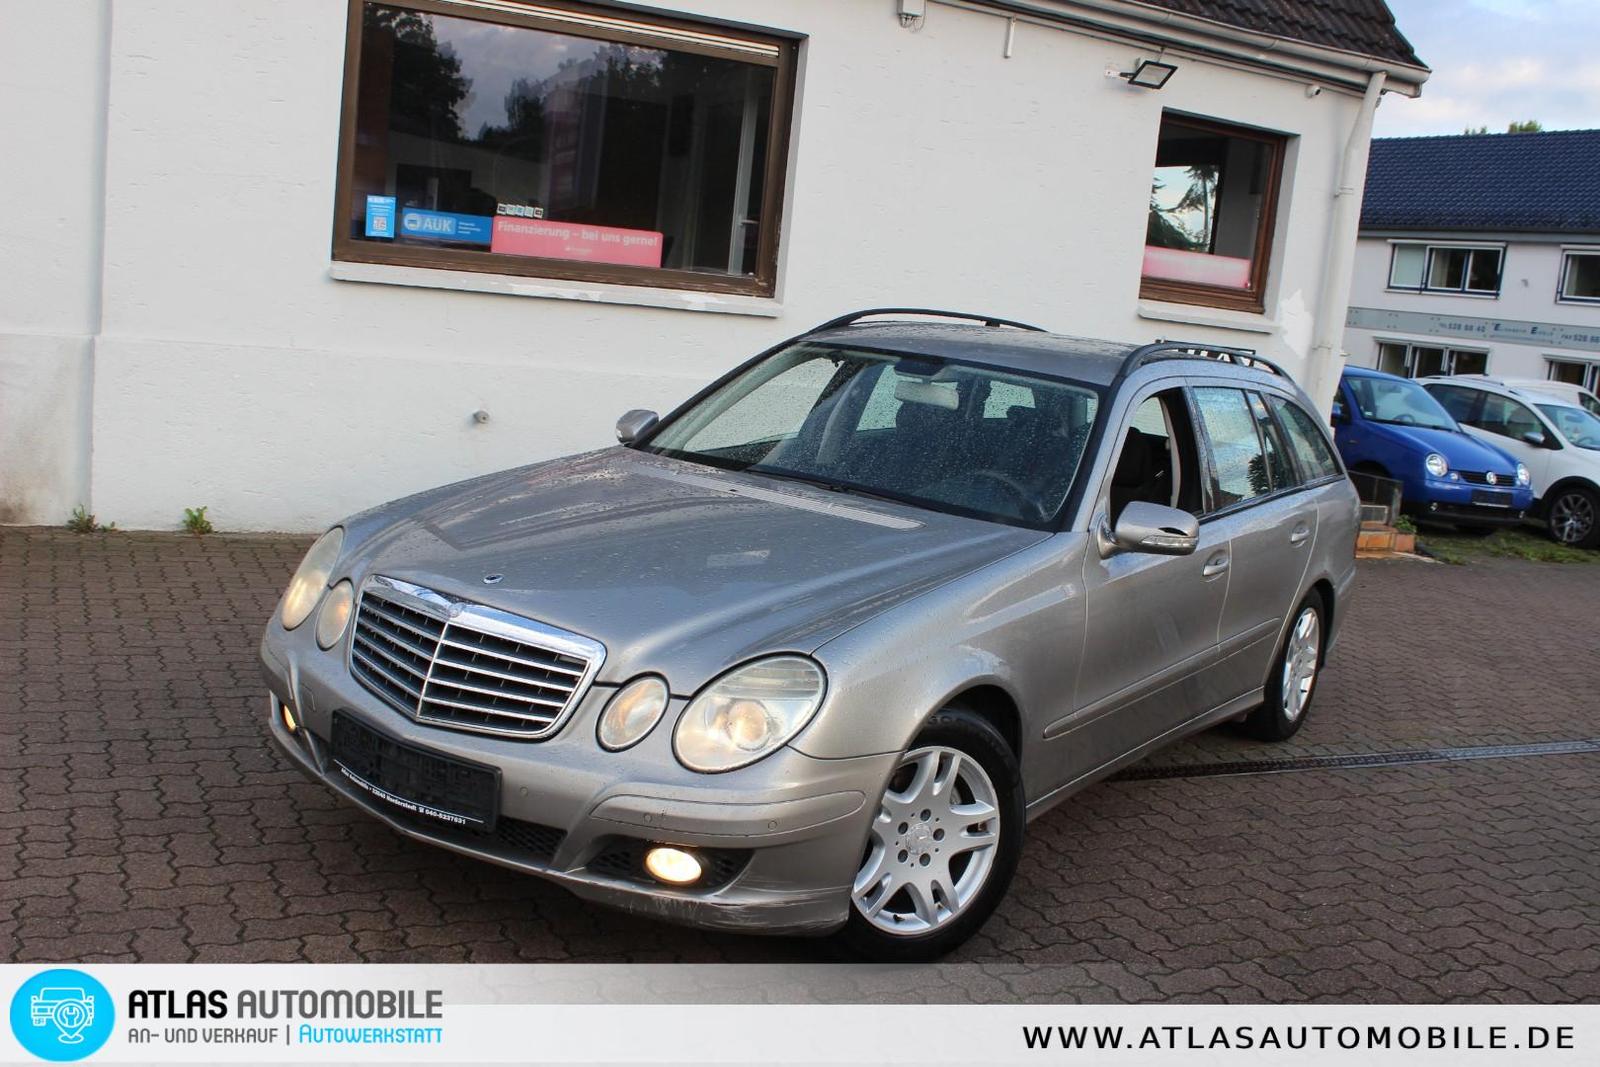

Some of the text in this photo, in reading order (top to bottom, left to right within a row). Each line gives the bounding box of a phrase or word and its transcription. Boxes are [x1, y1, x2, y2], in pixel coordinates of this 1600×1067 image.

[423, 217, 451, 232] AUK
[497, 221, 570, 240] Finanzierung
[581, 229, 599, 241] bei
[601, 232, 620, 243] uns
[623, 235, 659, 247] gerne!
